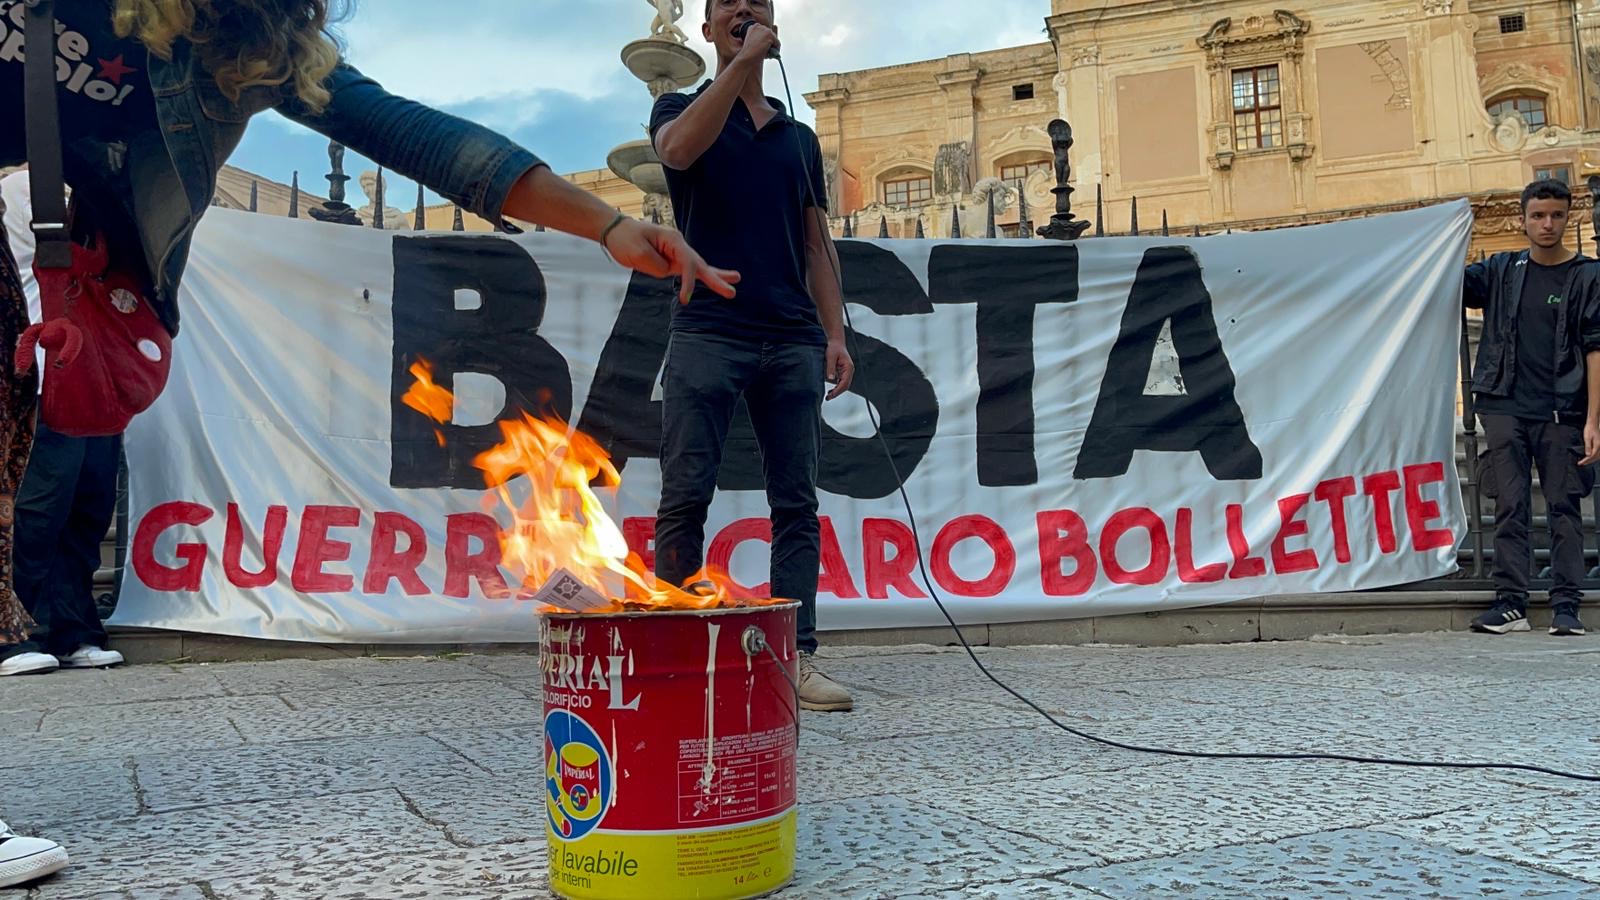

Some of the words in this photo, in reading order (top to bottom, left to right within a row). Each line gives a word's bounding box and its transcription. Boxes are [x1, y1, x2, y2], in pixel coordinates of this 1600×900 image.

[388, 234, 1263, 499] BASTA
[131, 500, 545, 600] GUERR
[706, 513, 1016, 600] CARO
[1036, 460, 1455, 597] BOLLETTE
[564, 764, 595, 781] IMPERIAL
[562, 843, 638, 877] lavabile
[562, 870, 591, 889] interni
[734, 875, 744, 885] 14
